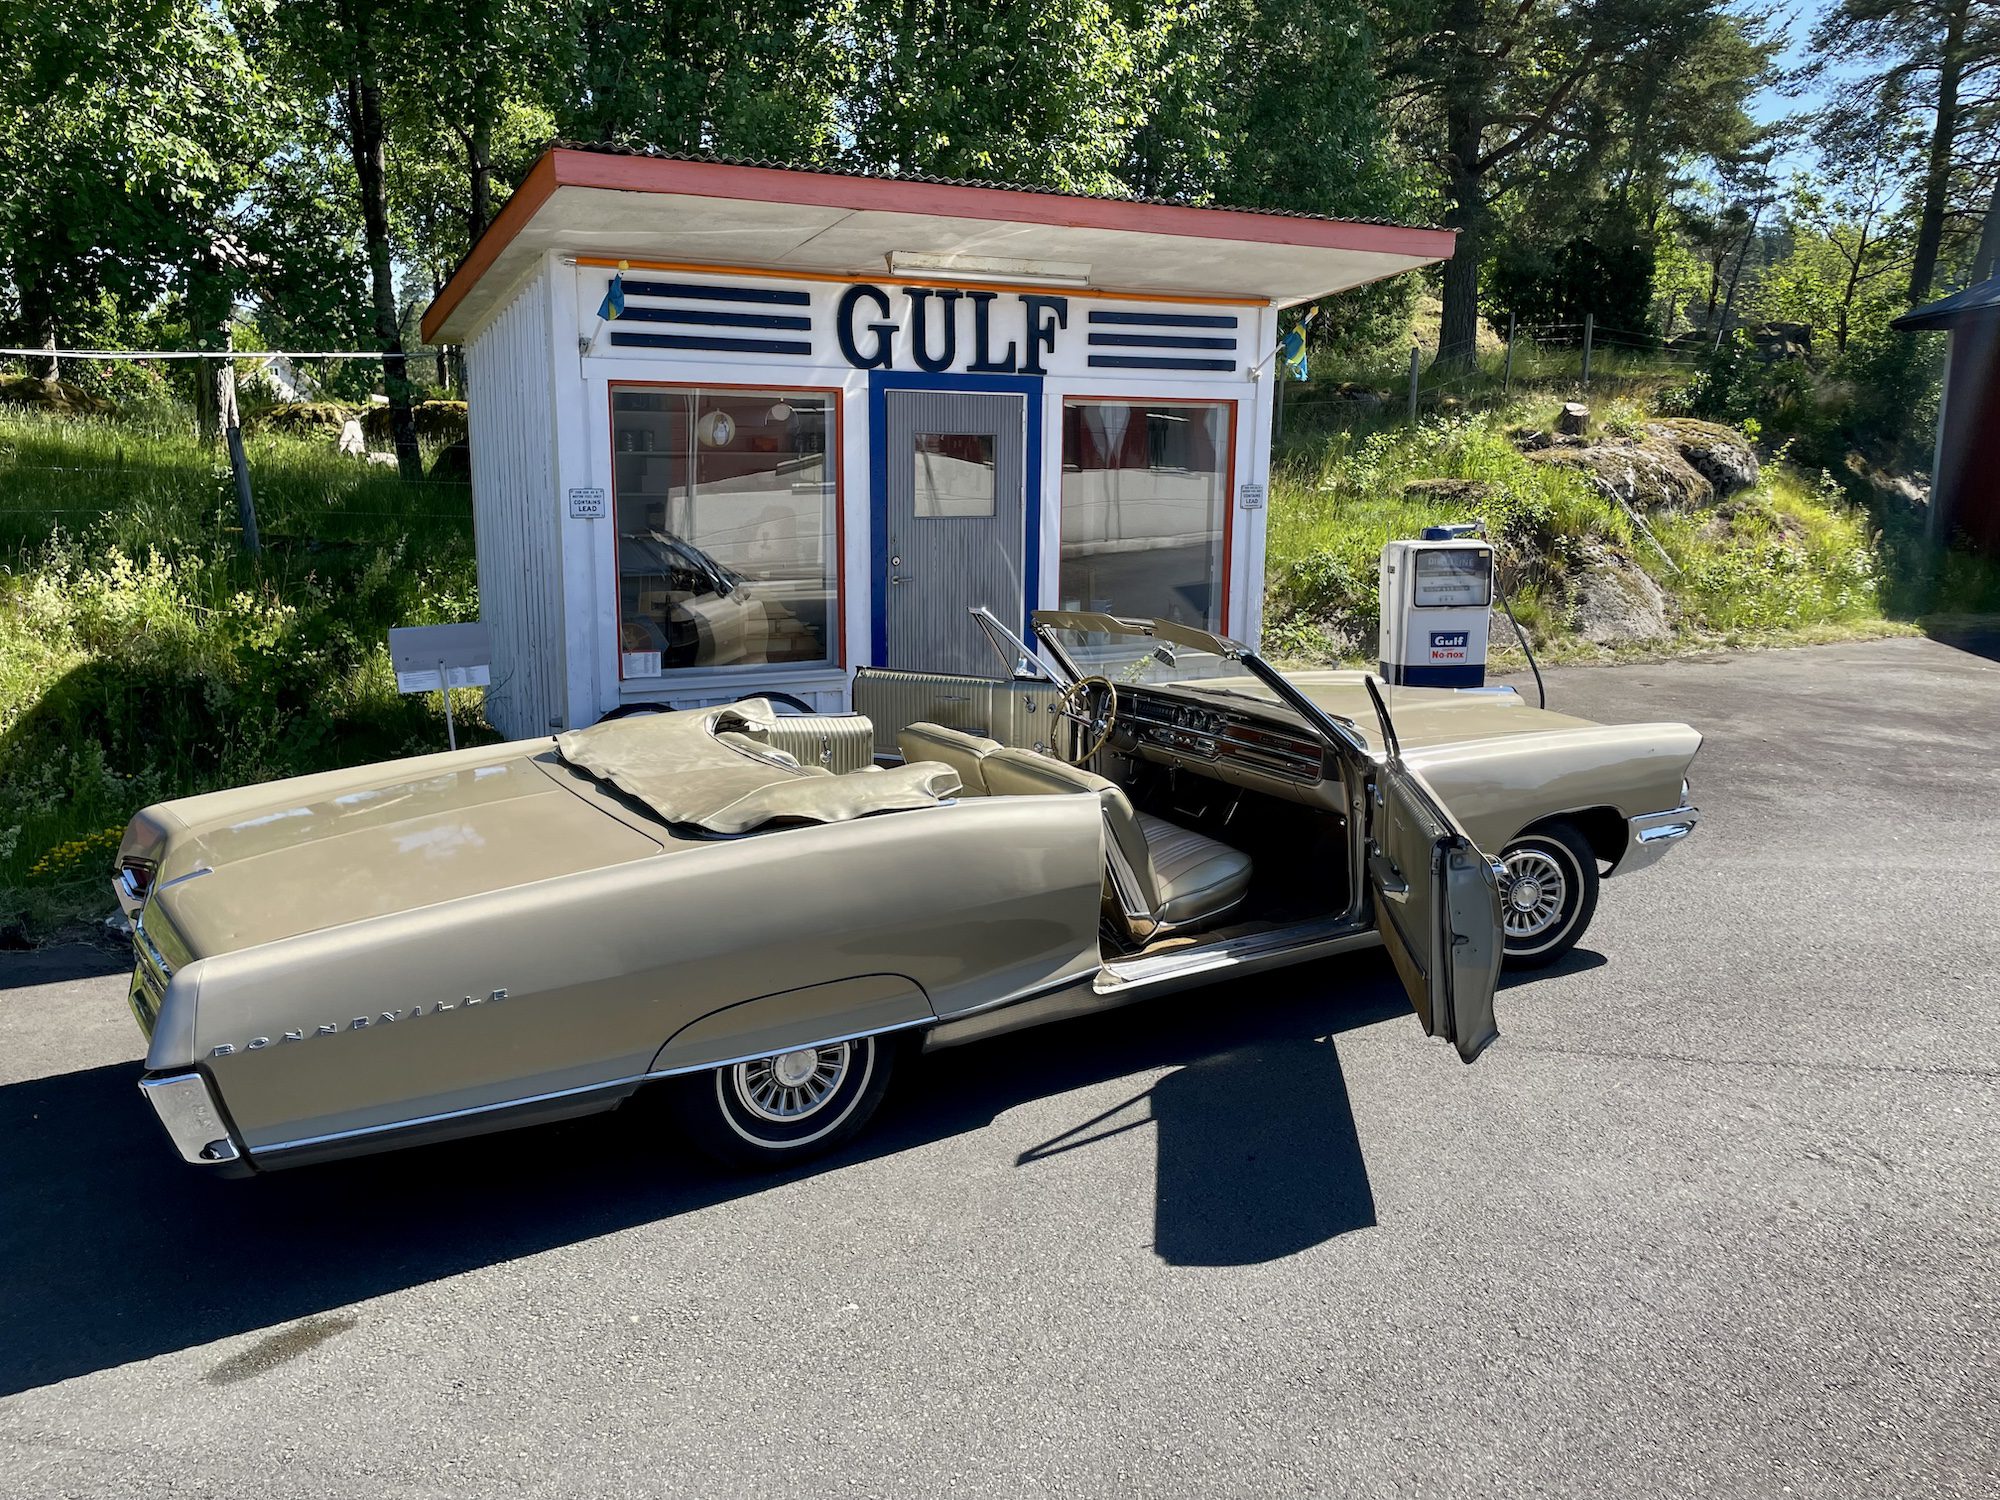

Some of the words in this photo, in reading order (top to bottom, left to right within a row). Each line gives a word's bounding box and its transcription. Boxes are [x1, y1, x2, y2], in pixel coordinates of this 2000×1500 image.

[837, 284, 1068, 375] GULF
[1432, 650, 1464, 659] No-nox
[1434, 635, 1464, 646] Gulf
[213, 987, 508, 1057] BONNEVILLE
